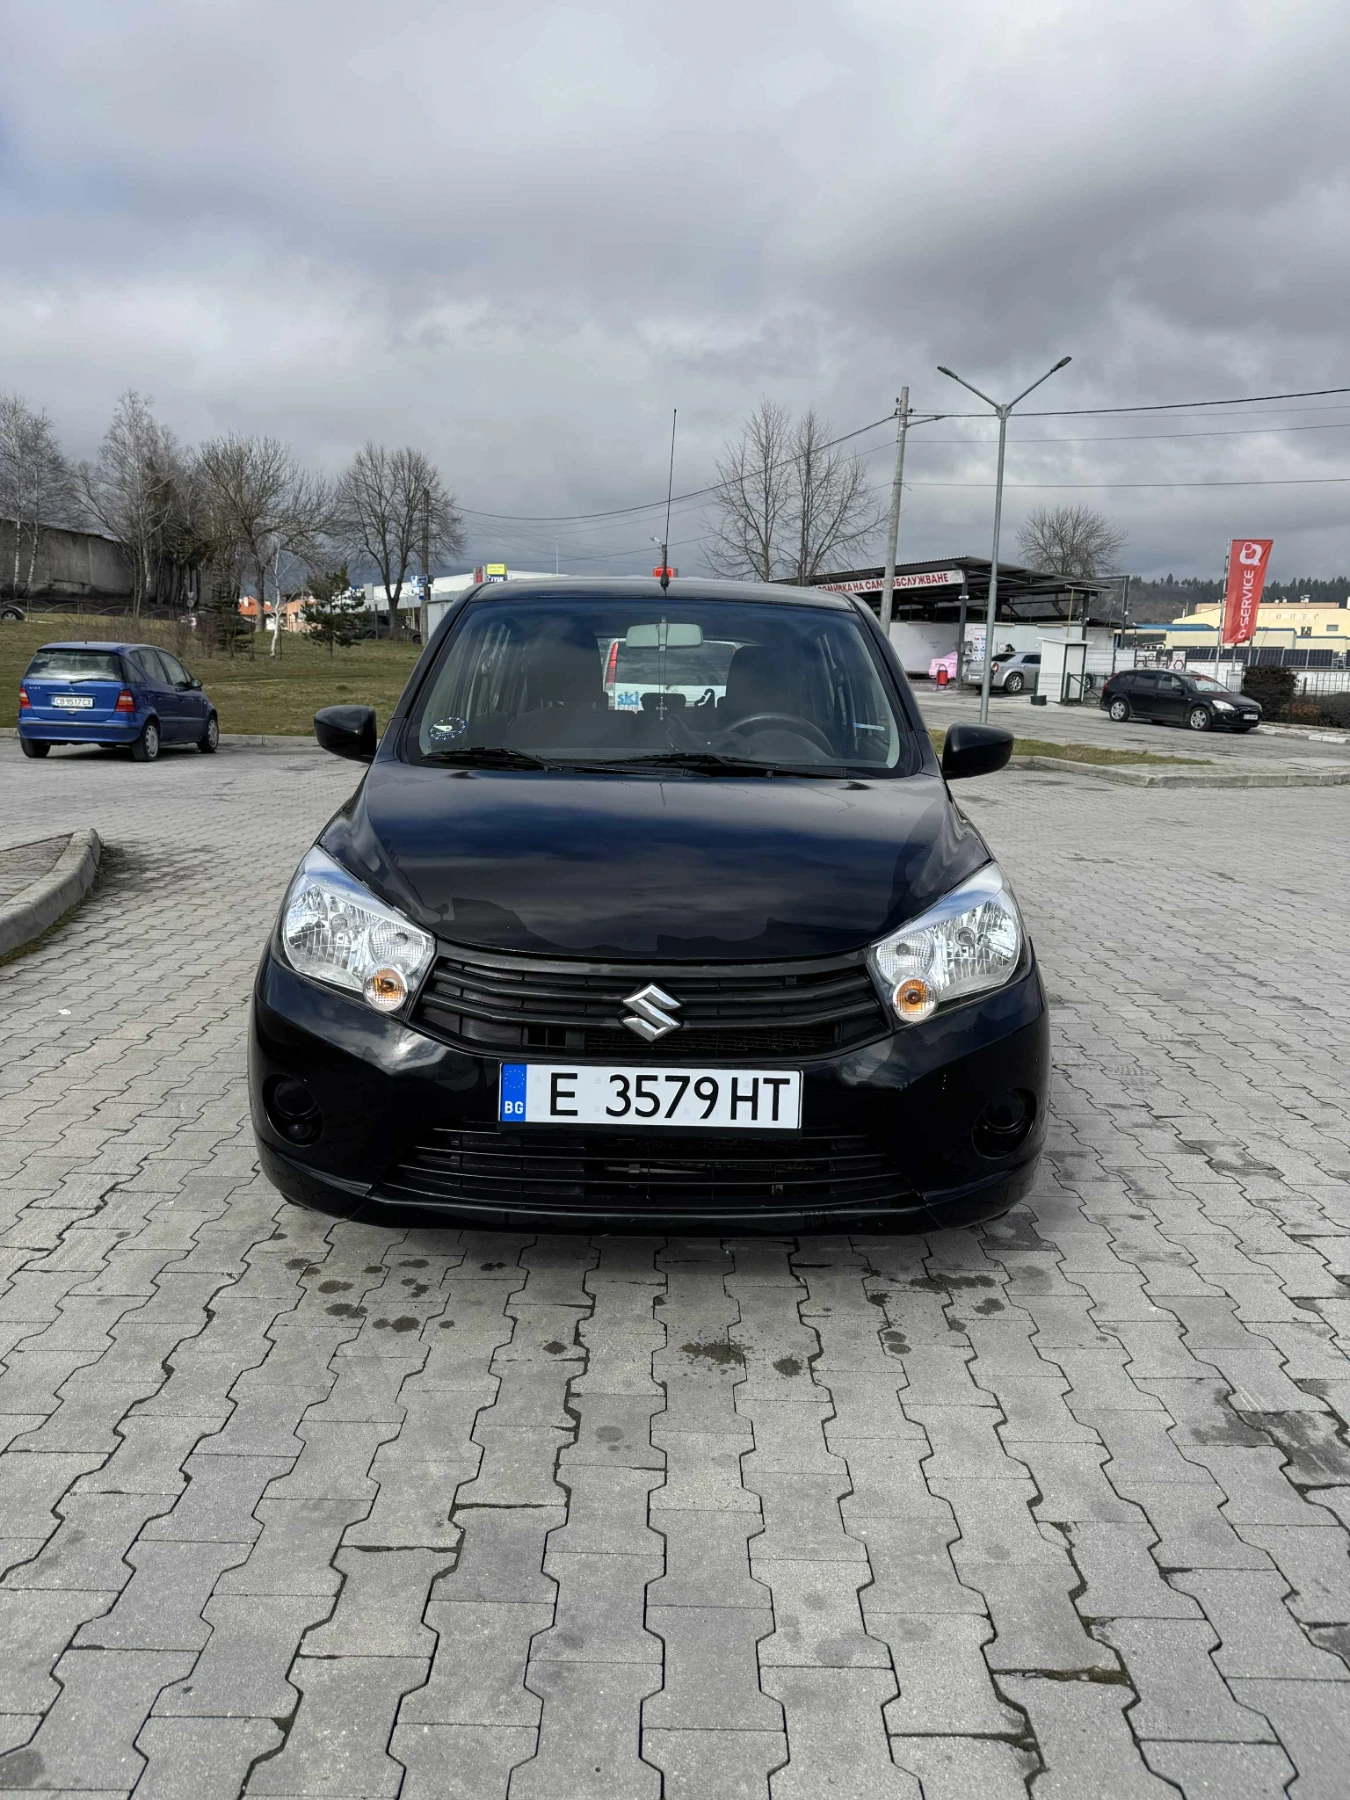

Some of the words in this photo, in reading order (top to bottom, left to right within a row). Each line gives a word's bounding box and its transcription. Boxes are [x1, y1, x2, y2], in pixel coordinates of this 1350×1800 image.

[854, 582, 864, 591] НА
[866, 573, 949, 591] САМОБСЛУЖВАНЕ
[550, 1072, 578, 1116] E
[606, 1074, 719, 1119] 3579
[730, 1076, 791, 1121] HT
[504, 1101, 523, 1114] BG
